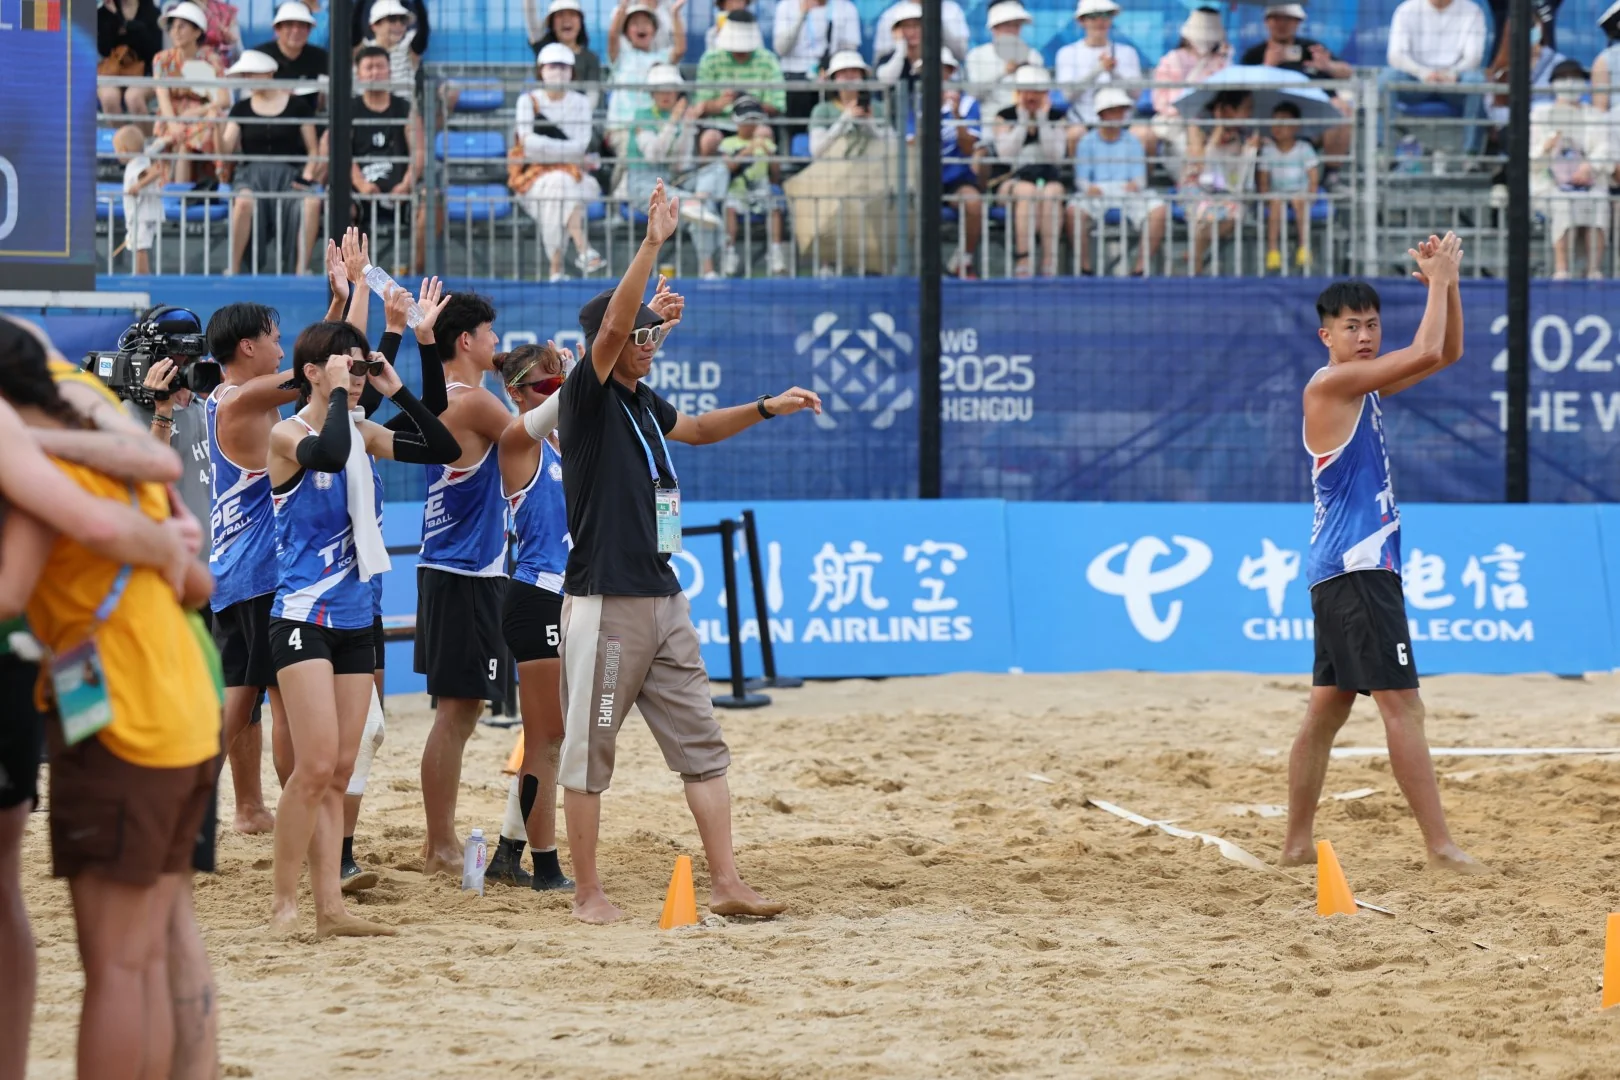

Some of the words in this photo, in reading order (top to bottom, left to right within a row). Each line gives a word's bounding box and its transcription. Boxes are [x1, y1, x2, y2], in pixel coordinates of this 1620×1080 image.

[1490, 314, 1620, 372] 02
[940, 354, 1035, 392] 2025
[1491, 391, 1581, 432] THE
[425, 491, 446, 521] E
[1237, 538, 1528, 617] 中电信
[288, 627, 303, 651] 4
[545, 624, 560, 646] 5
[802, 616, 973, 643] AIRLINES
[488, 658, 498, 680] 9
[602, 641, 620, 690] CHINESE
[597, 692, 615, 727] TAIPEI
